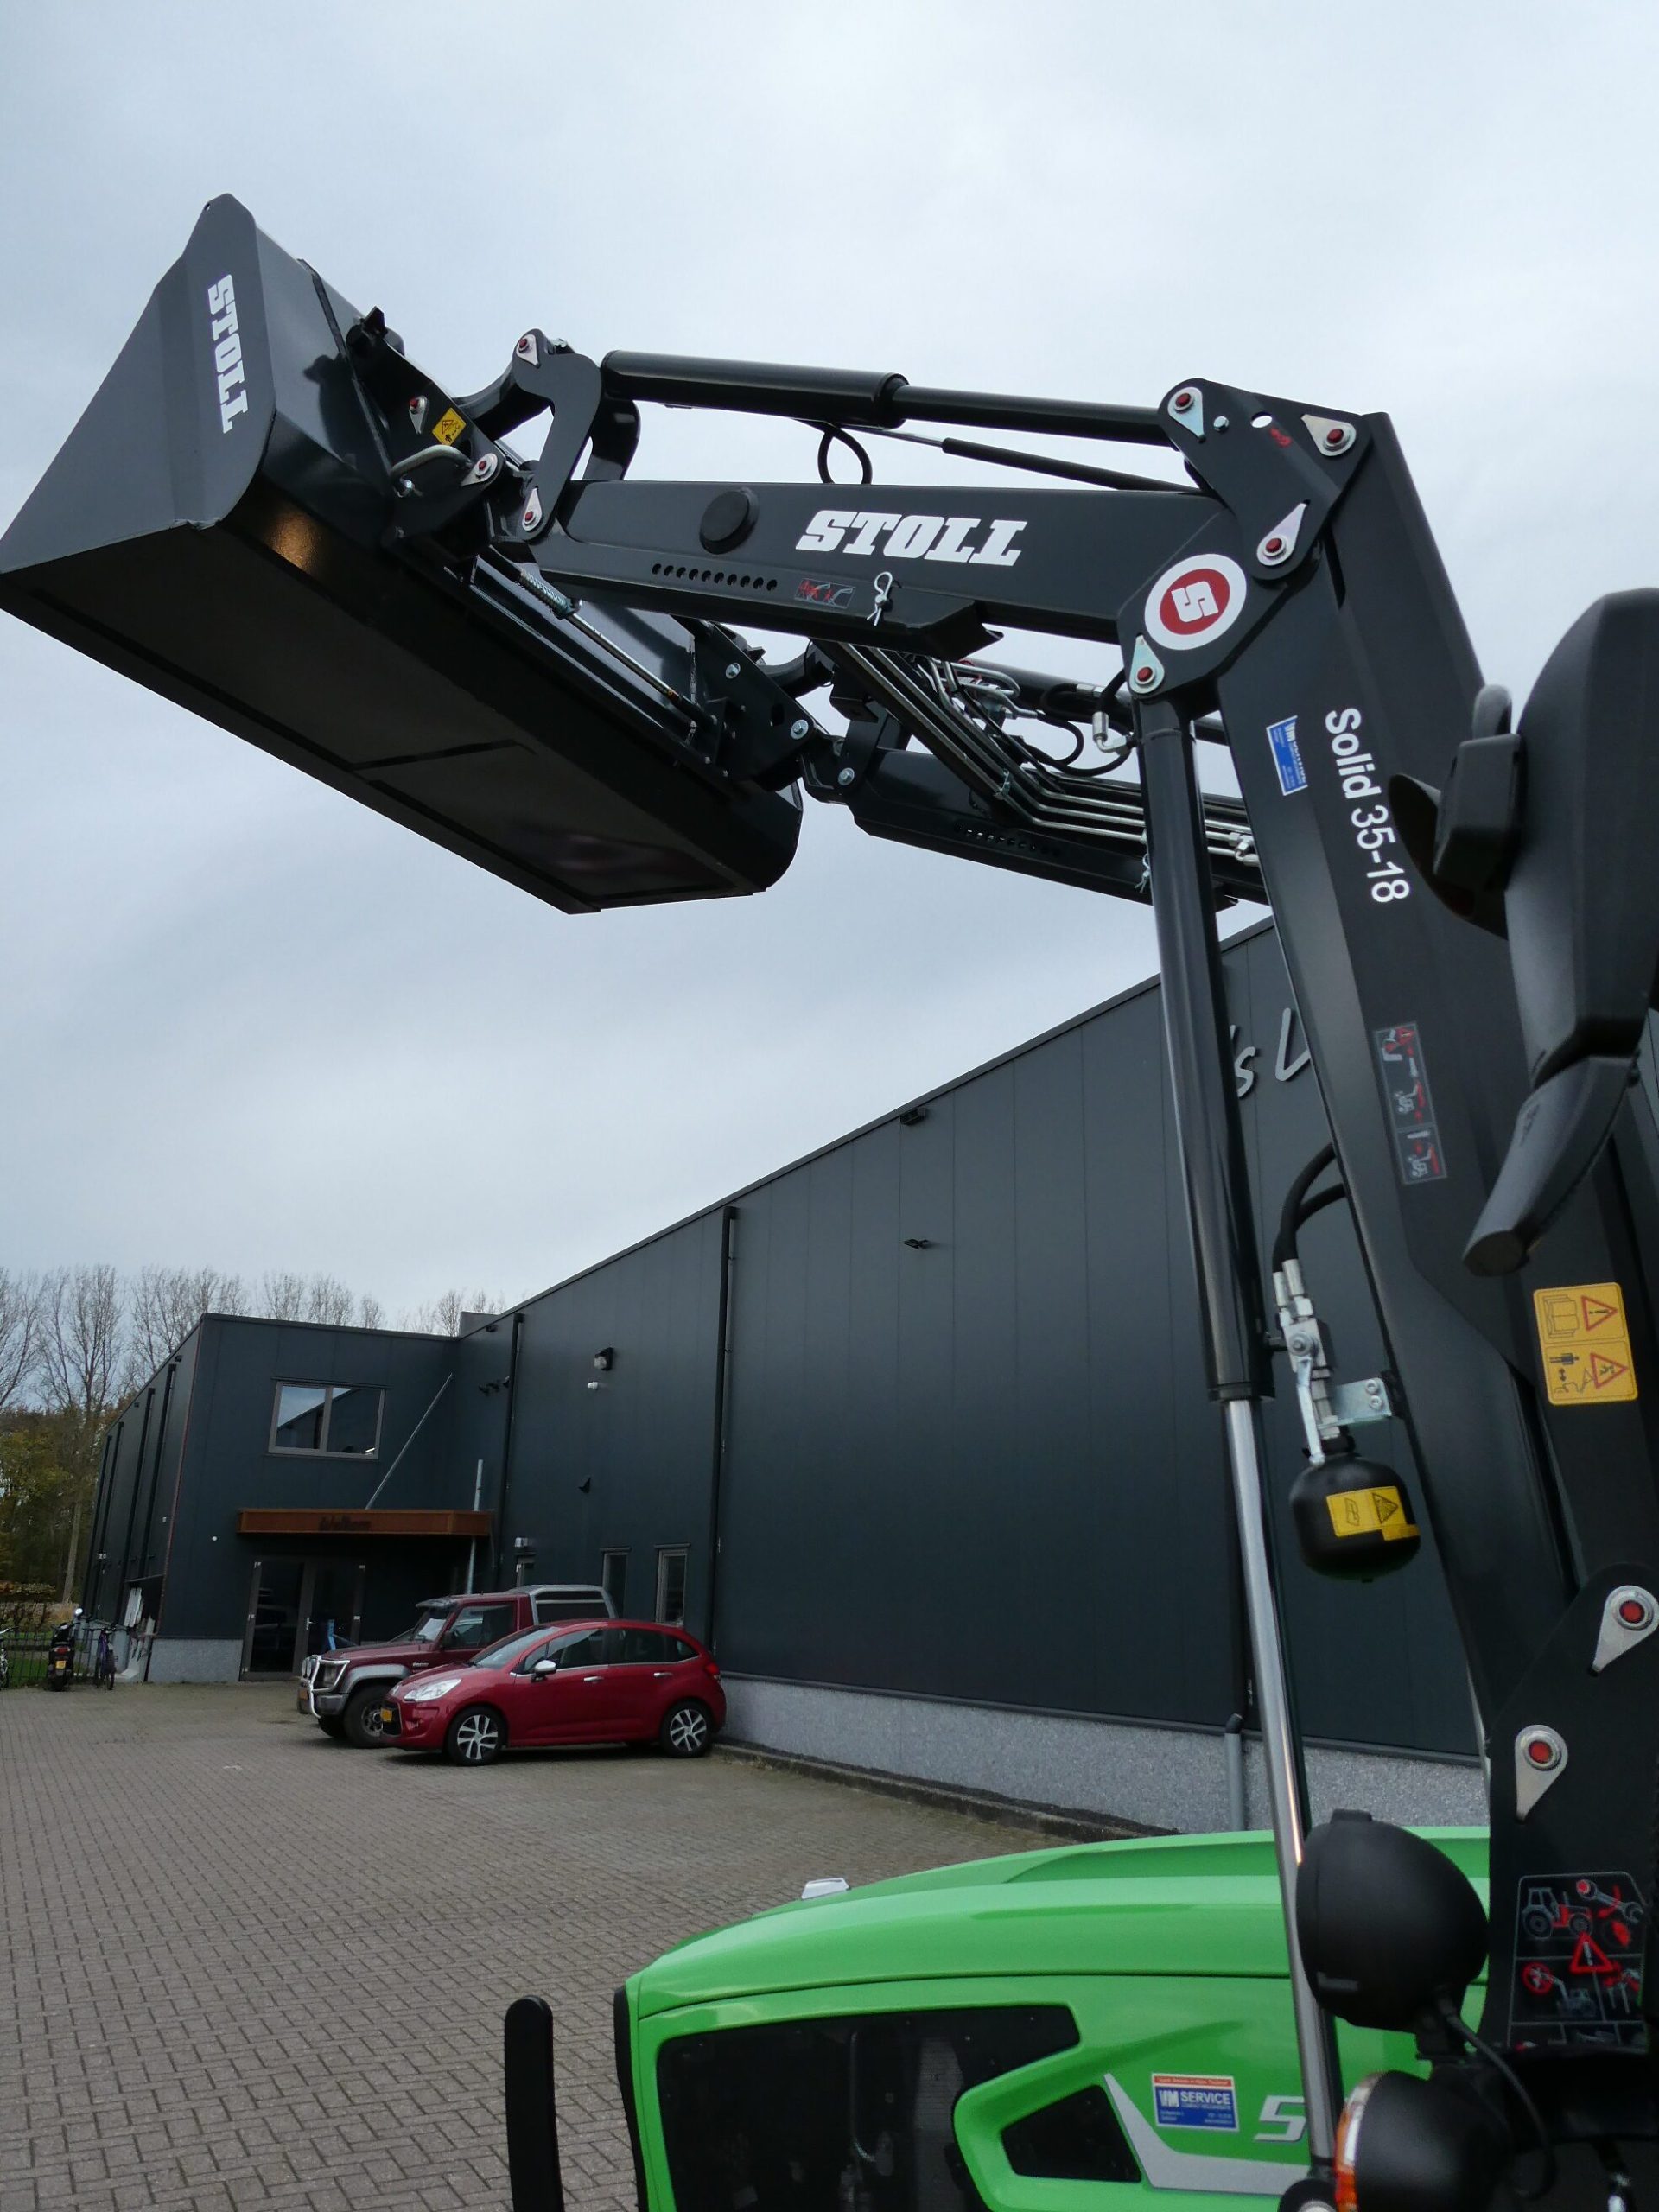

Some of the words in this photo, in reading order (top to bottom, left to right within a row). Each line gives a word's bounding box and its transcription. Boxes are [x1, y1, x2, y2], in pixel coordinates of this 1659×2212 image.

[207, 274, 249, 434] STOLL
[795, 510, 1028, 567] STOLL
[1325, 708, 1382, 799] Solid
[1351, 804, 1410, 903] 35-18
[1180, 2091, 1231, 2105] SERVICE
